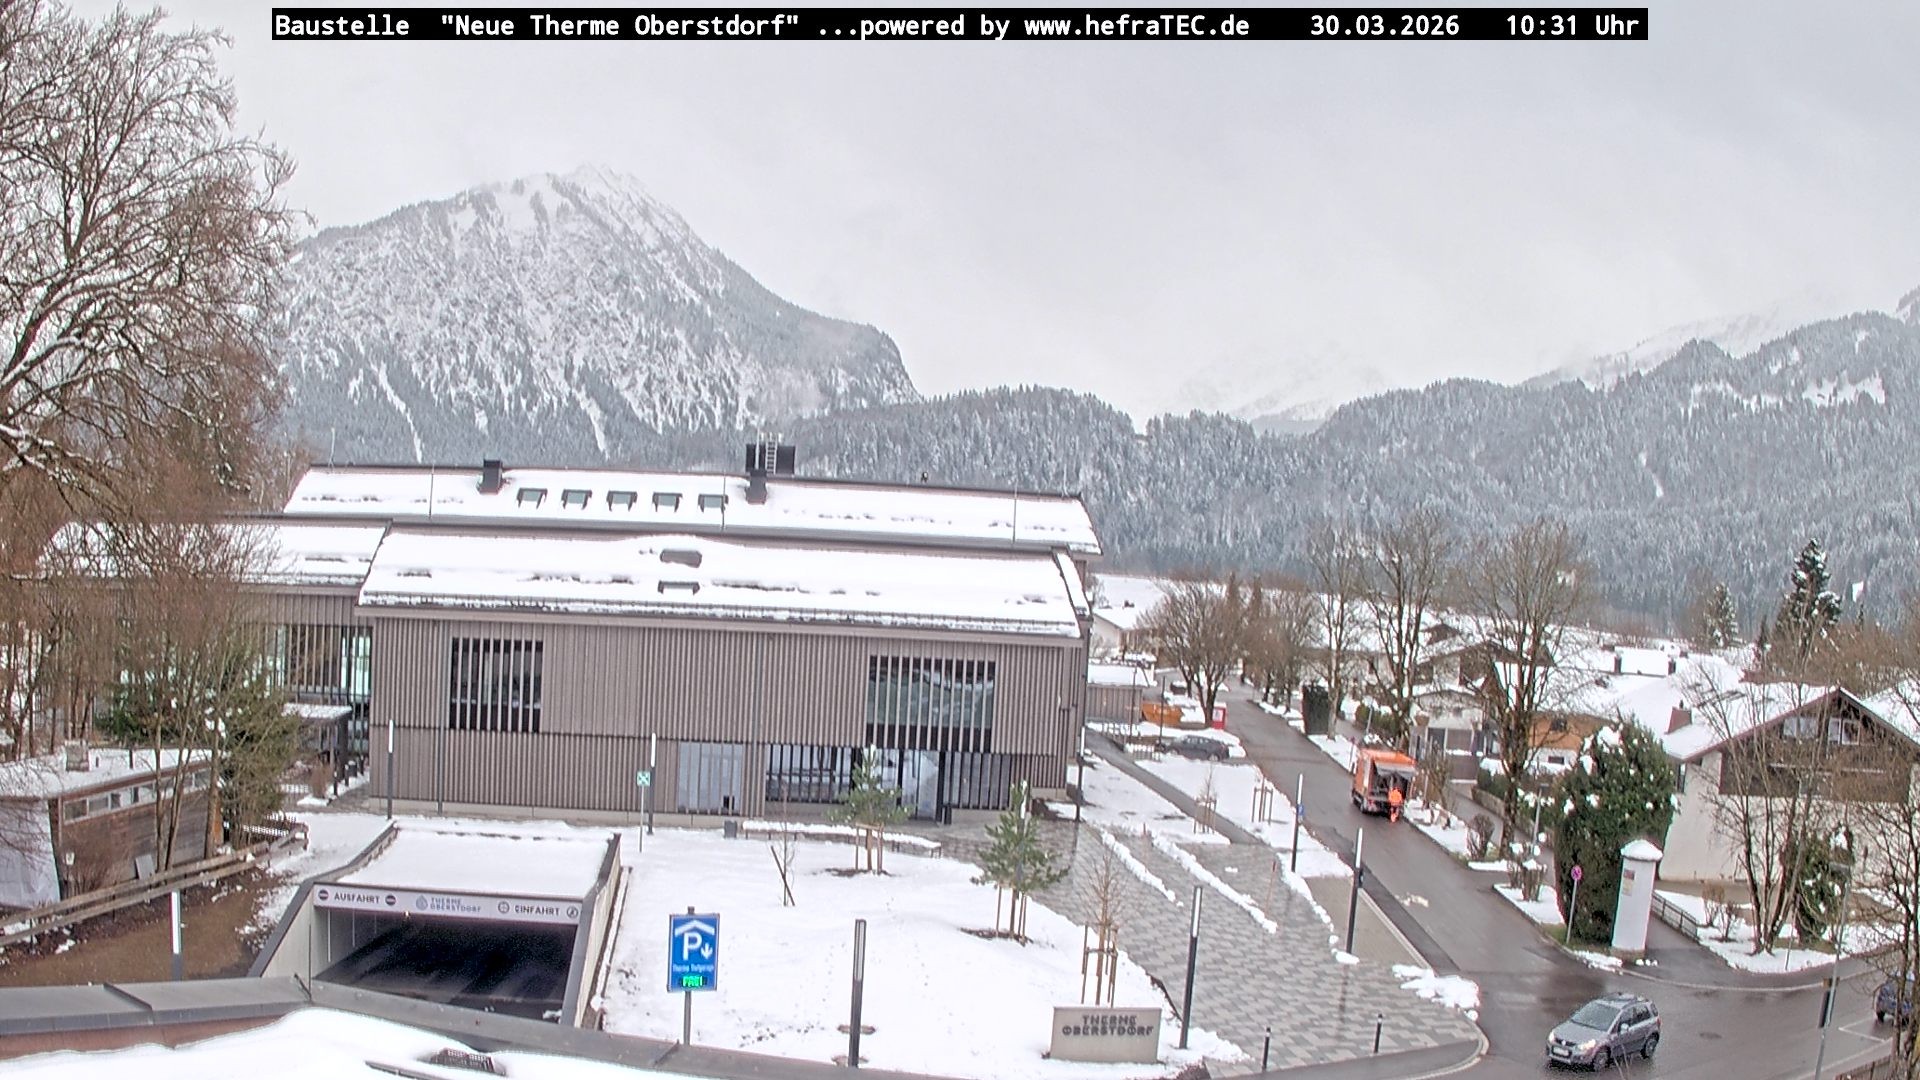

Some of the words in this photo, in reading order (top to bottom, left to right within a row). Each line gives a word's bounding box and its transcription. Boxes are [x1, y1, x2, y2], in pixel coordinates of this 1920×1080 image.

[334, 892, 380, 904] AUSFAHRT
[515, 905, 560, 916] EINFAHRT
[683, 932, 702, 961] P
[1082, 1015, 1137, 1026] THERME
[1062, 1025, 1154, 1036] OBERSTDORF
